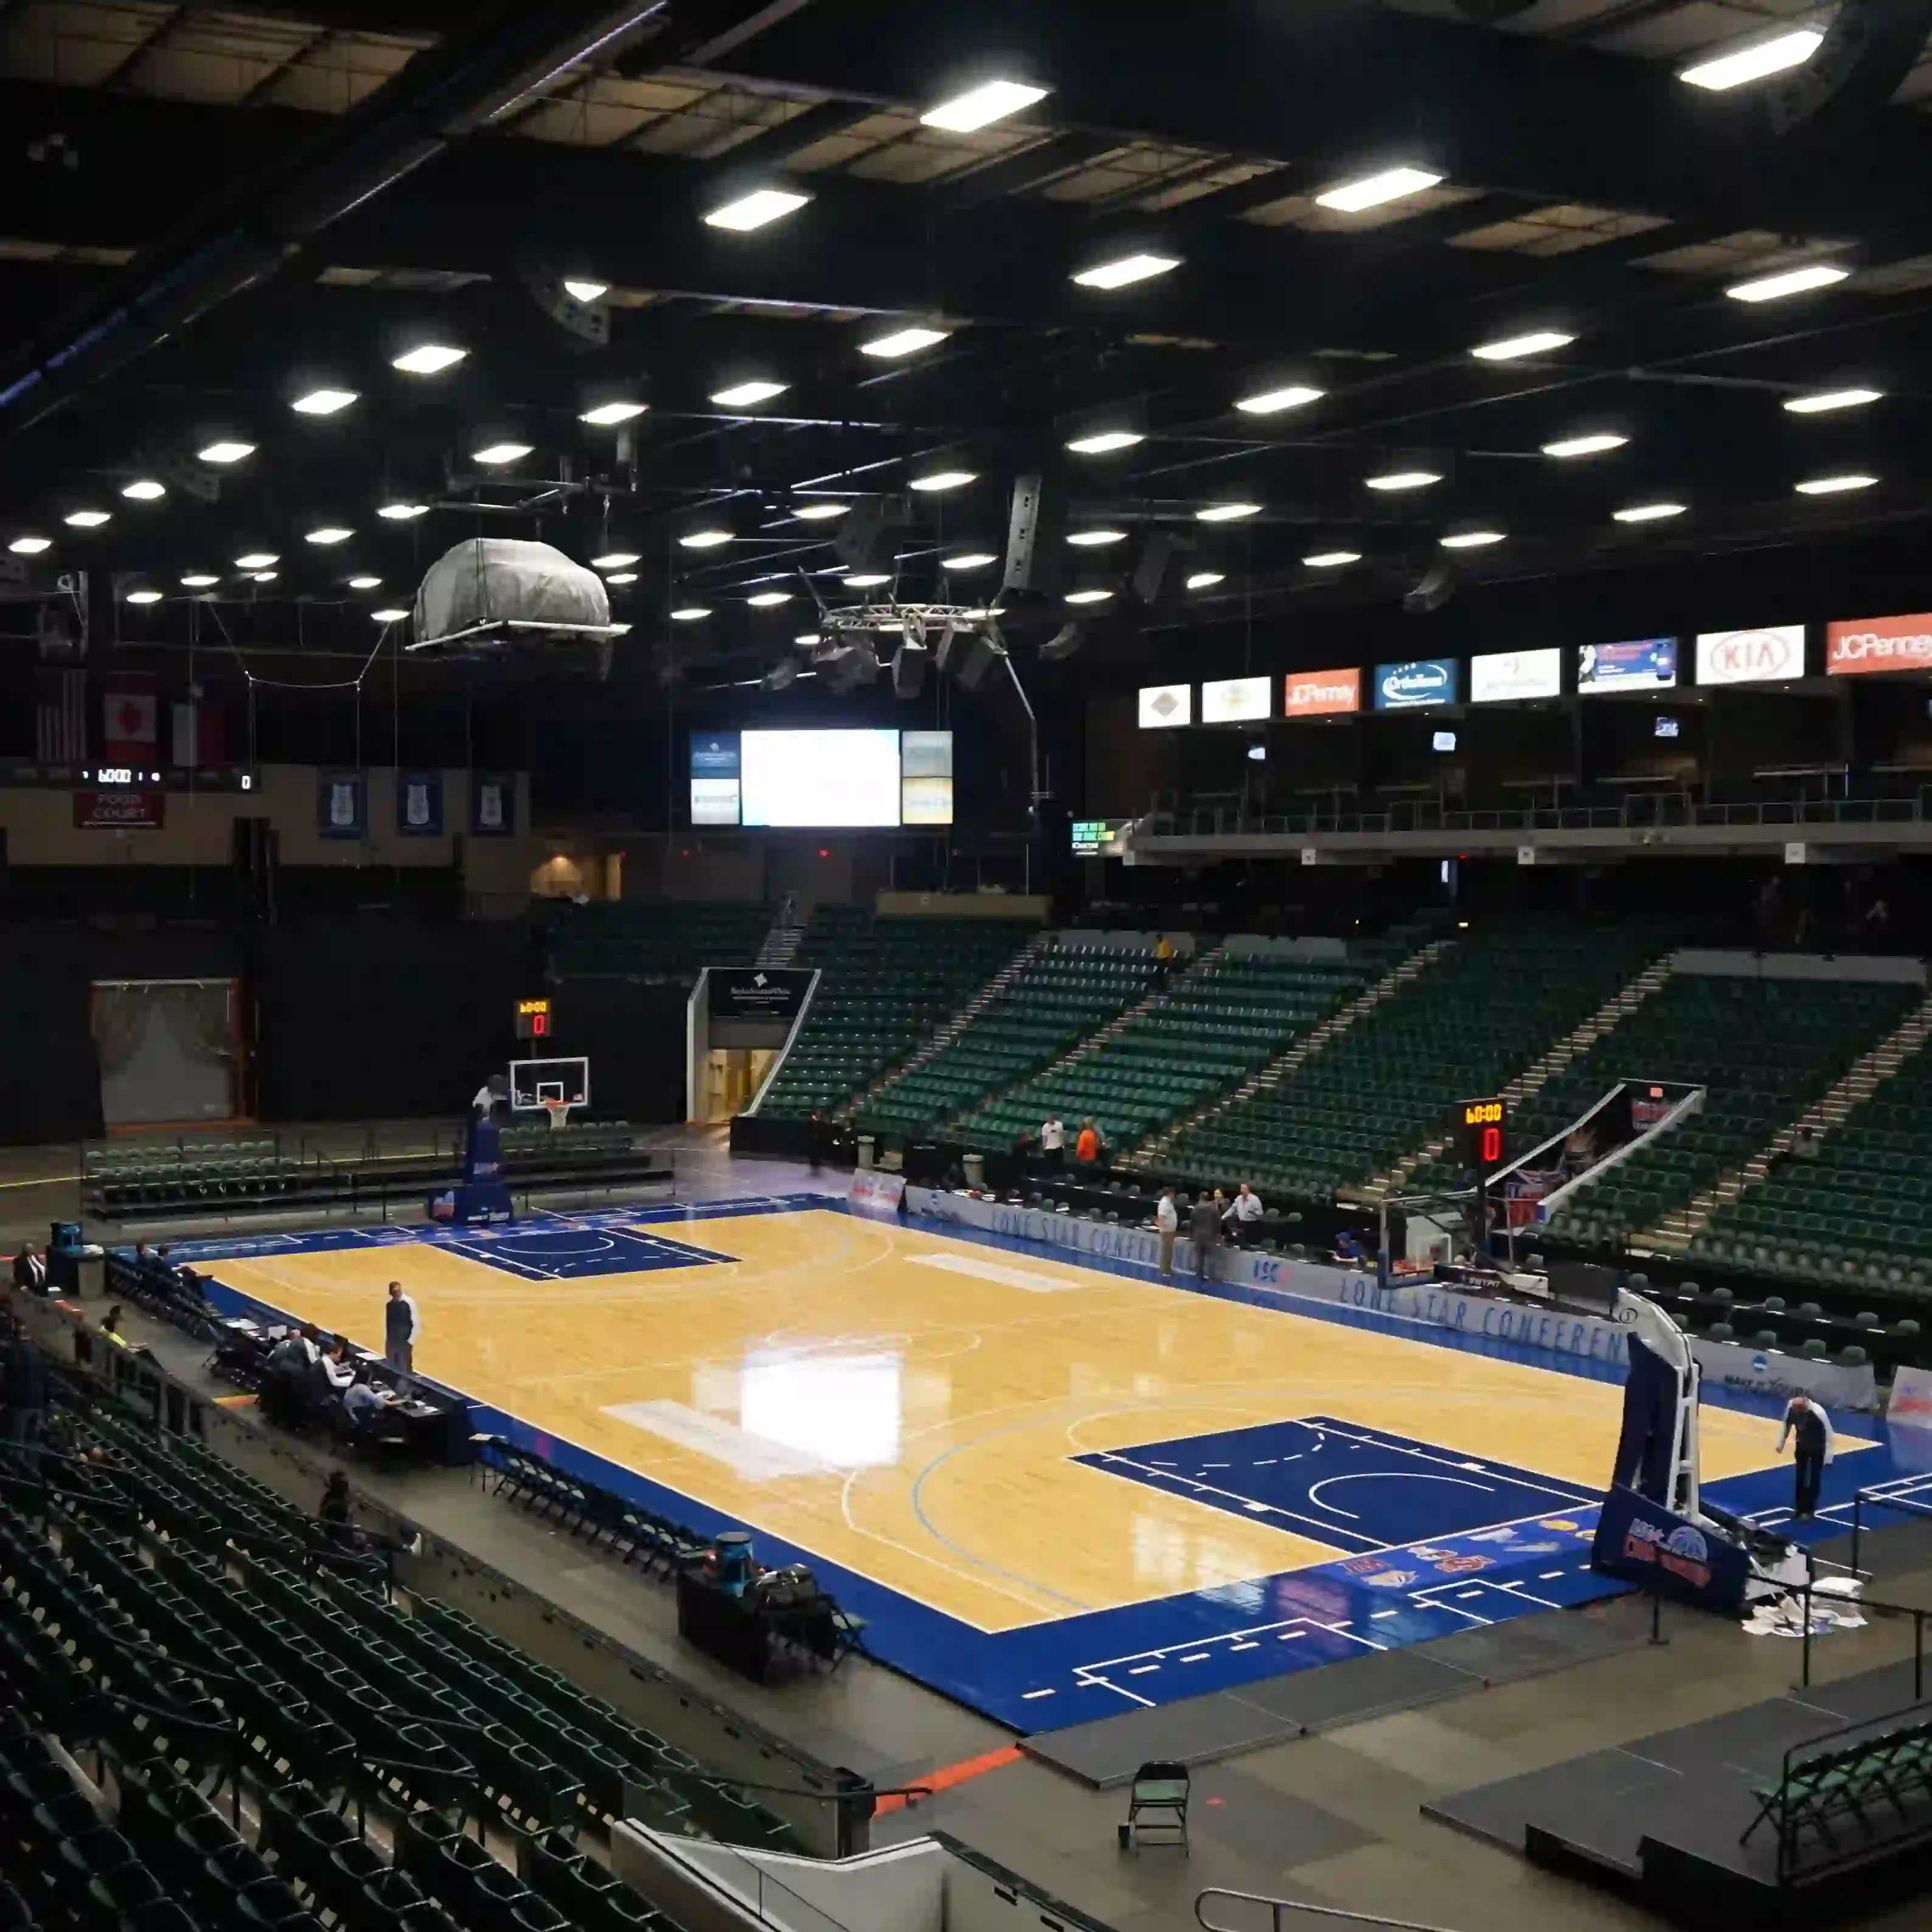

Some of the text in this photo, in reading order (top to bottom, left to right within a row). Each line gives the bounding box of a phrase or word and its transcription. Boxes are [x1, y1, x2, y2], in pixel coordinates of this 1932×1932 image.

[1723, 643, 1774, 670] KIA
[98, 794, 142, 804] FOOD
[92, 808, 145, 818] COURT
[533, 1014, 546, 1034] 0
[1484, 1128, 1499, 1161] 0
[1341, 1277, 1625, 1361] LONE STAR CONFEREN
